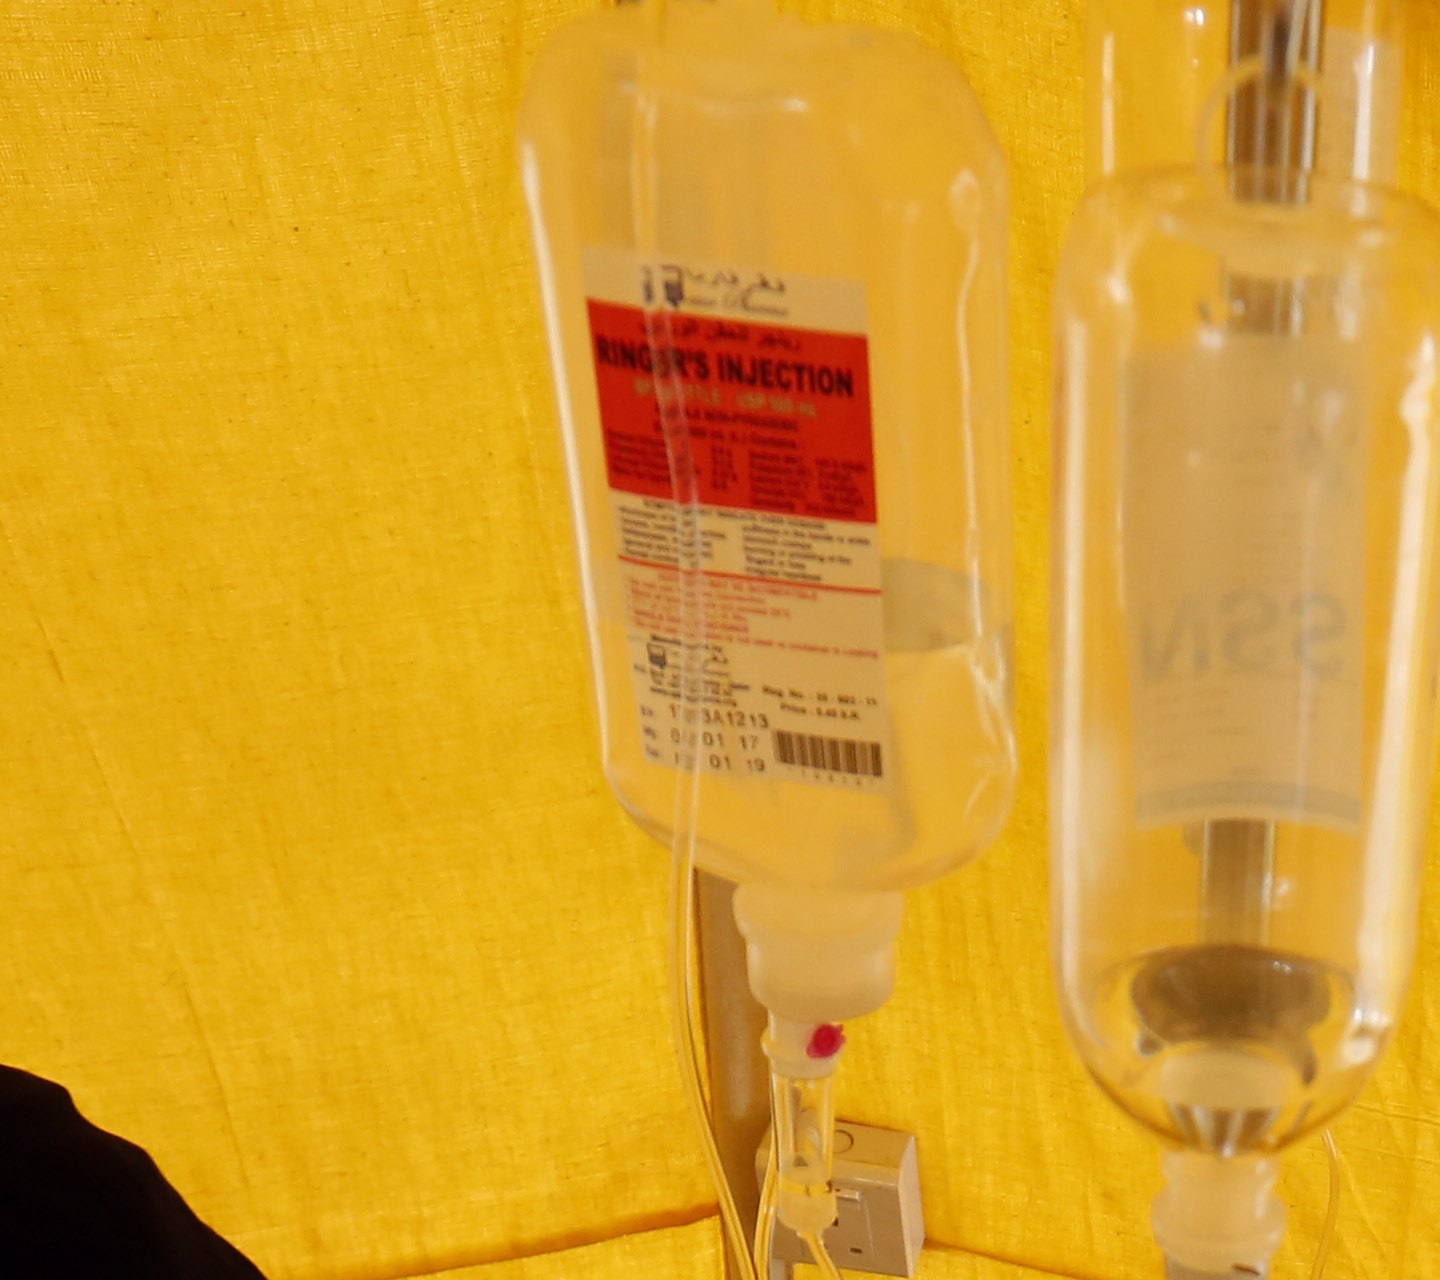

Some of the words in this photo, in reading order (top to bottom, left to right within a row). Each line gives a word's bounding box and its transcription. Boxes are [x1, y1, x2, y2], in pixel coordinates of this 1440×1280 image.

[717, 353, 854, 398] INJECTION
[702, 730, 725, 747] 01
[739, 735, 759, 751] 17
[709, 754, 732, 770] 01
